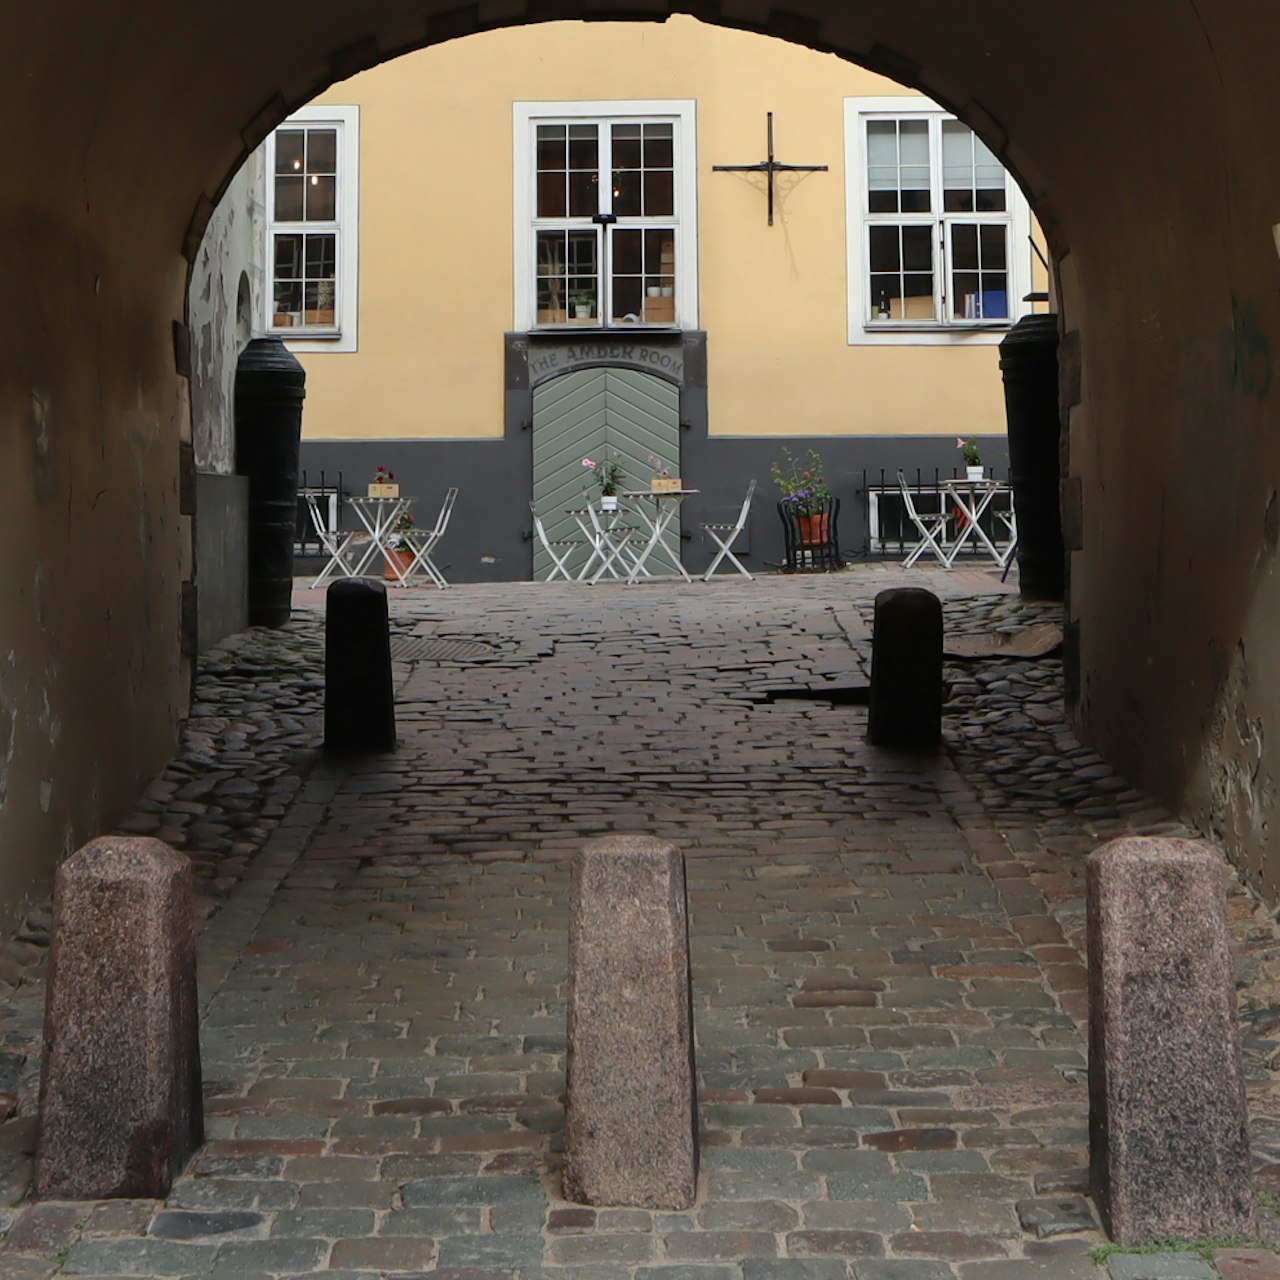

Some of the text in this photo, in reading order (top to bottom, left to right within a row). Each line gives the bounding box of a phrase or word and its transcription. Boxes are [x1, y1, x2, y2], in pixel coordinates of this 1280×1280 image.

[529, 344, 683, 376] THE AMBER ROOM
